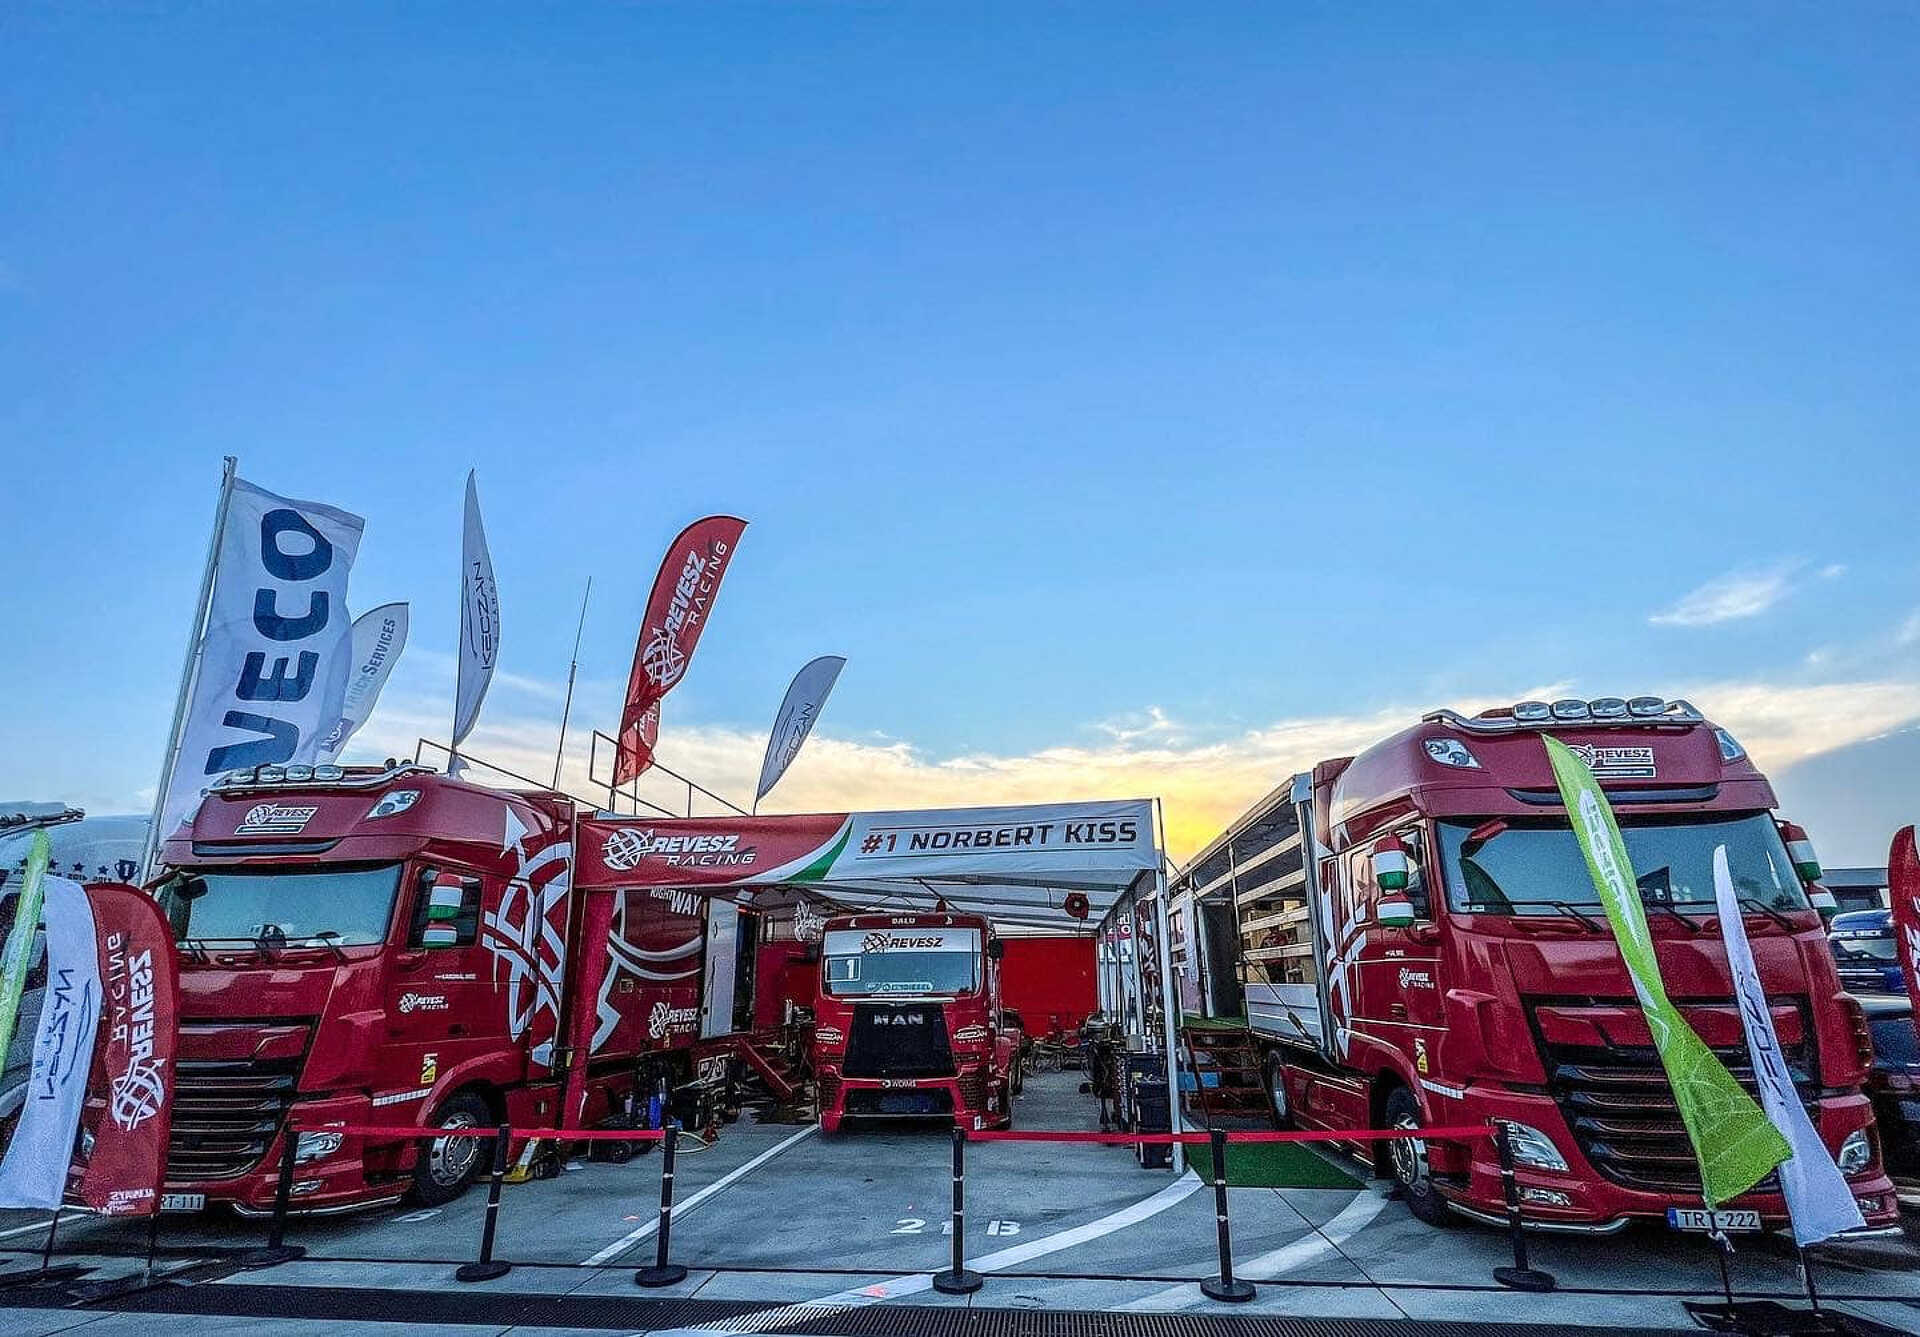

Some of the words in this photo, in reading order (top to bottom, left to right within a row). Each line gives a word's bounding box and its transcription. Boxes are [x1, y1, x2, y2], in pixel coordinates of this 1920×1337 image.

[664, 550, 706, 634] REVESZ
[686, 541, 728, 627] RACING
[1596, 750, 1651, 759] REVESZ
[651, 835, 740, 853] REVESZ
[860, 833, 898, 853] #1
[909, 825, 1054, 850] NORBERT
[1064, 822, 1138, 843] KISS
[660, 853, 757, 866] RACING
[671, 889, 702, 916] WAY
[889, 937, 943, 949] REVESZ
[846, 958, 856, 980] 1
[873, 1013, 924, 1025] MAN
